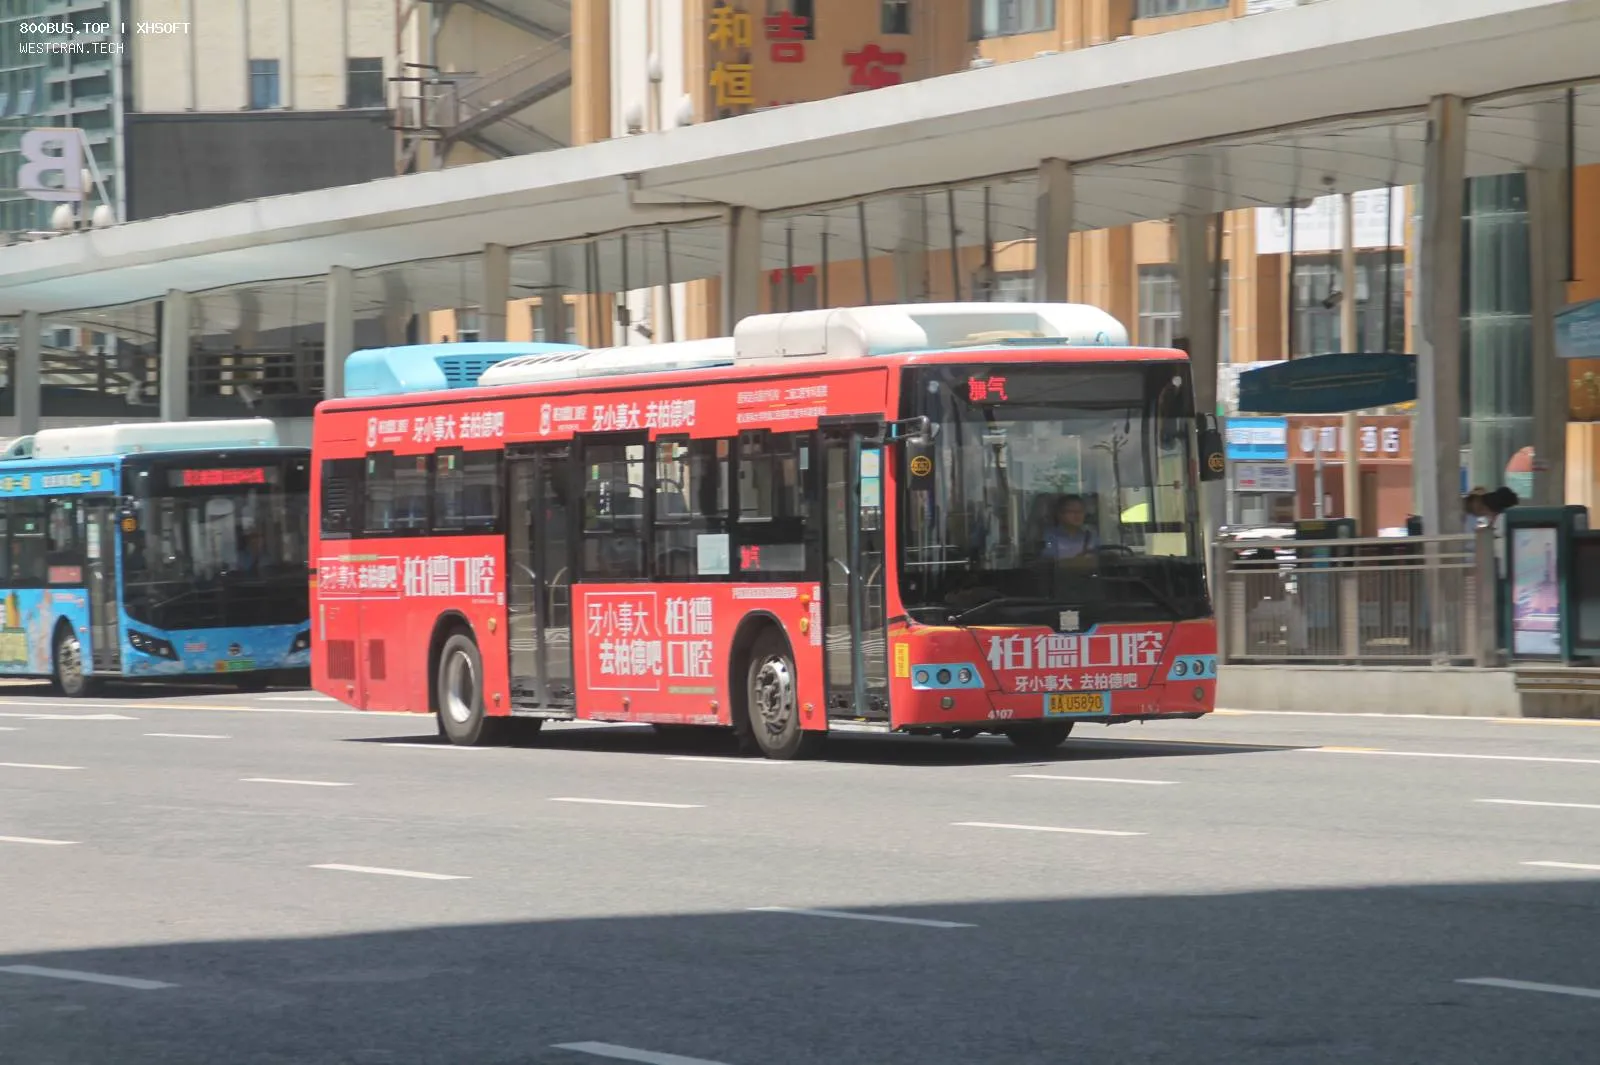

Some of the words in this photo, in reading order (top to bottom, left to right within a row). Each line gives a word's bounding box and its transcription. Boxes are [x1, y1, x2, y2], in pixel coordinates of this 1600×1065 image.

[763, 9, 808, 63] 吉
[708, 6, 755, 106] 和恒
[592, 402, 641, 431] 牙小事大
[403, 555, 496, 597] 柏德口腔
[587, 602, 650, 637] 牙小事大
[664, 596, 713, 635] 柏德
[599, 638, 664, 676] 去柏德吧
[667, 640, 713, 678] 口腔
[986, 630, 1164, 671] 柏德口腔
[1015, 674, 1073, 693] 牙小事大
[1079, 672, 1139, 691] 去柏德吧
